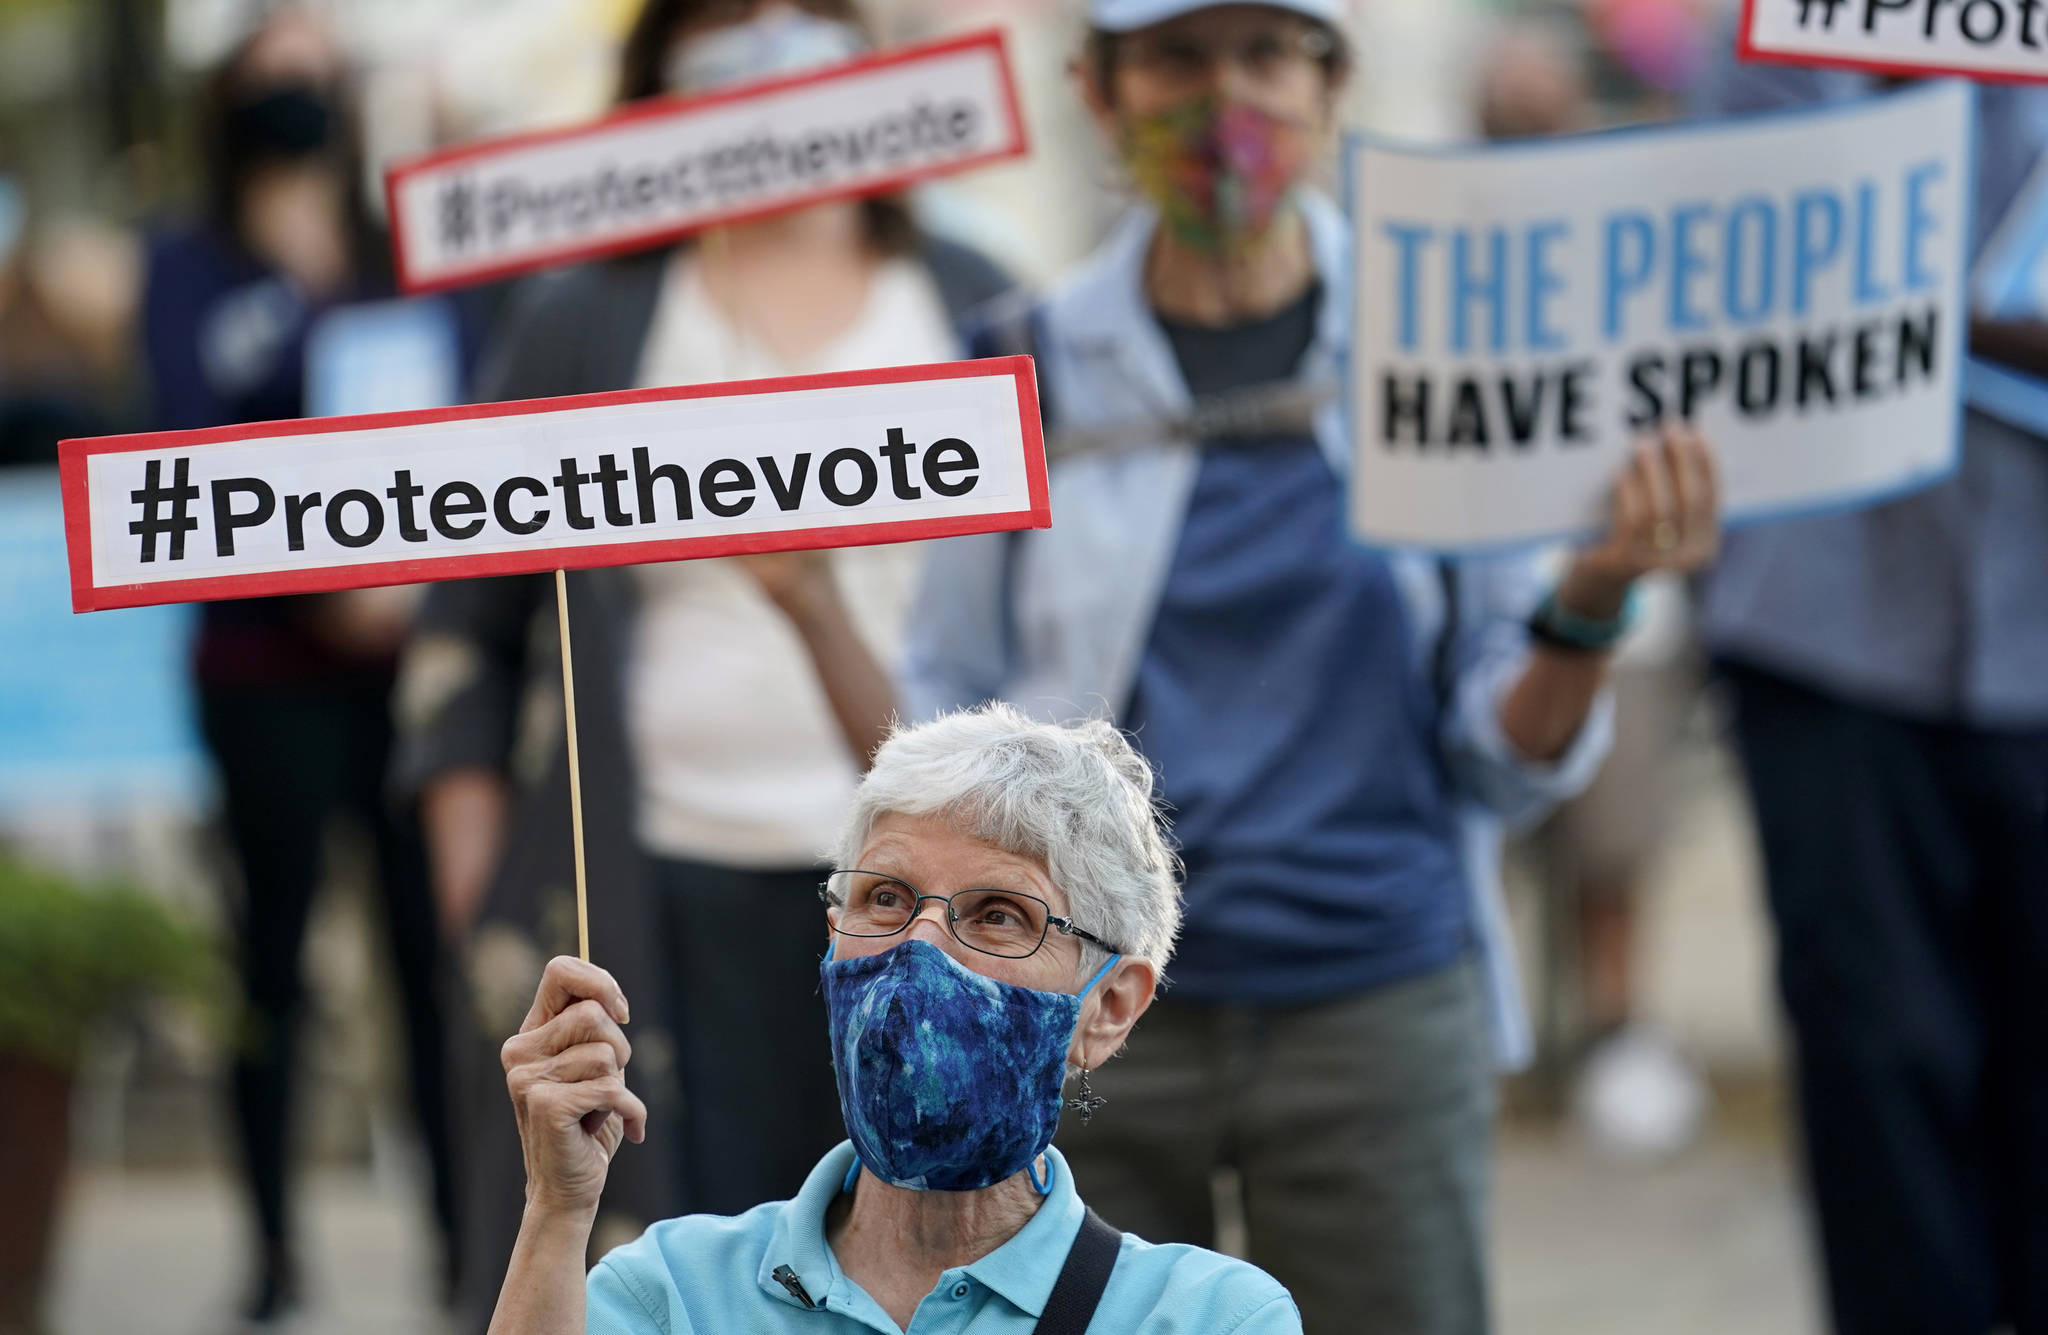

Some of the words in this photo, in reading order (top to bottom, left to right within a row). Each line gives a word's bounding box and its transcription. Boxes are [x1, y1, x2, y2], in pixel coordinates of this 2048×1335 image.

[1792, 0, 2048, 48] Prot
[1382, 217, 1572, 356] THE
[1599, 160, 1943, 342] PEOPLE
[1382, 364, 1589, 453] HAVE
[1625, 305, 1940, 435] SPOKEN
[128, 423, 980, 563] #Protectthevote
